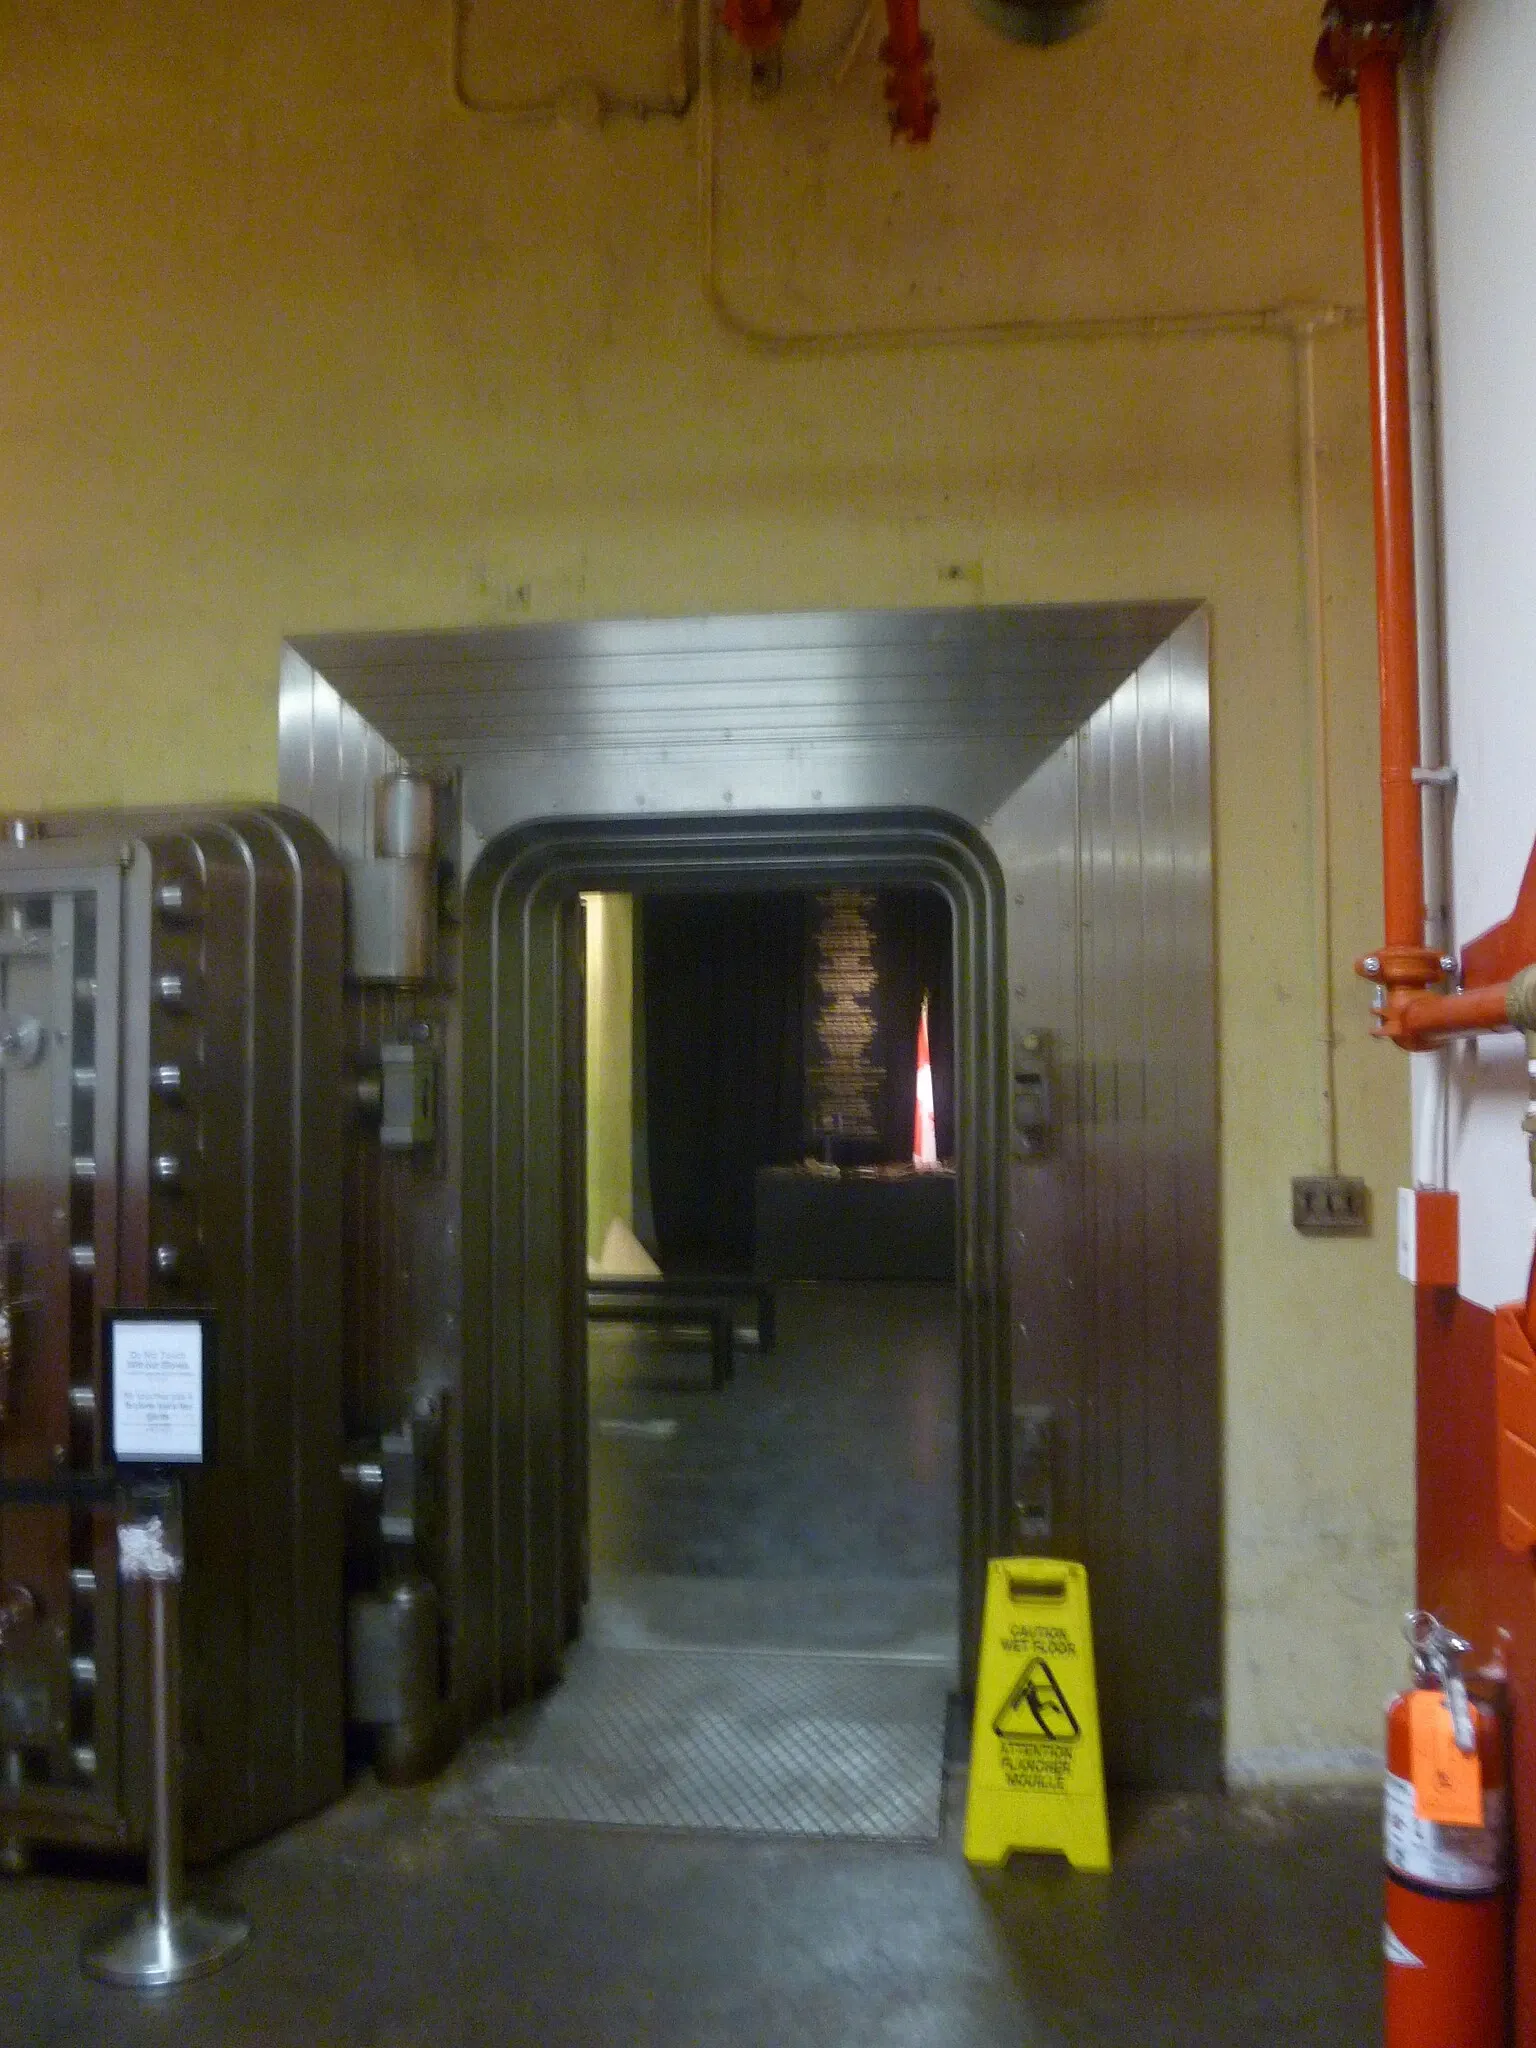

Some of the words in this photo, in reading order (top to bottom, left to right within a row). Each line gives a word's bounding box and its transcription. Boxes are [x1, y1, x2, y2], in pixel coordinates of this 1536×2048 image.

[1010, 1624, 1067, 1640] CAUTION
[1001, 1639, 1028, 1652] WET
[1033, 1640, 1076, 1655] FLOOR
[1001, 1743, 1072, 1760] ATTENTION
[1002, 1757, 1071, 1774] PLANCHER
